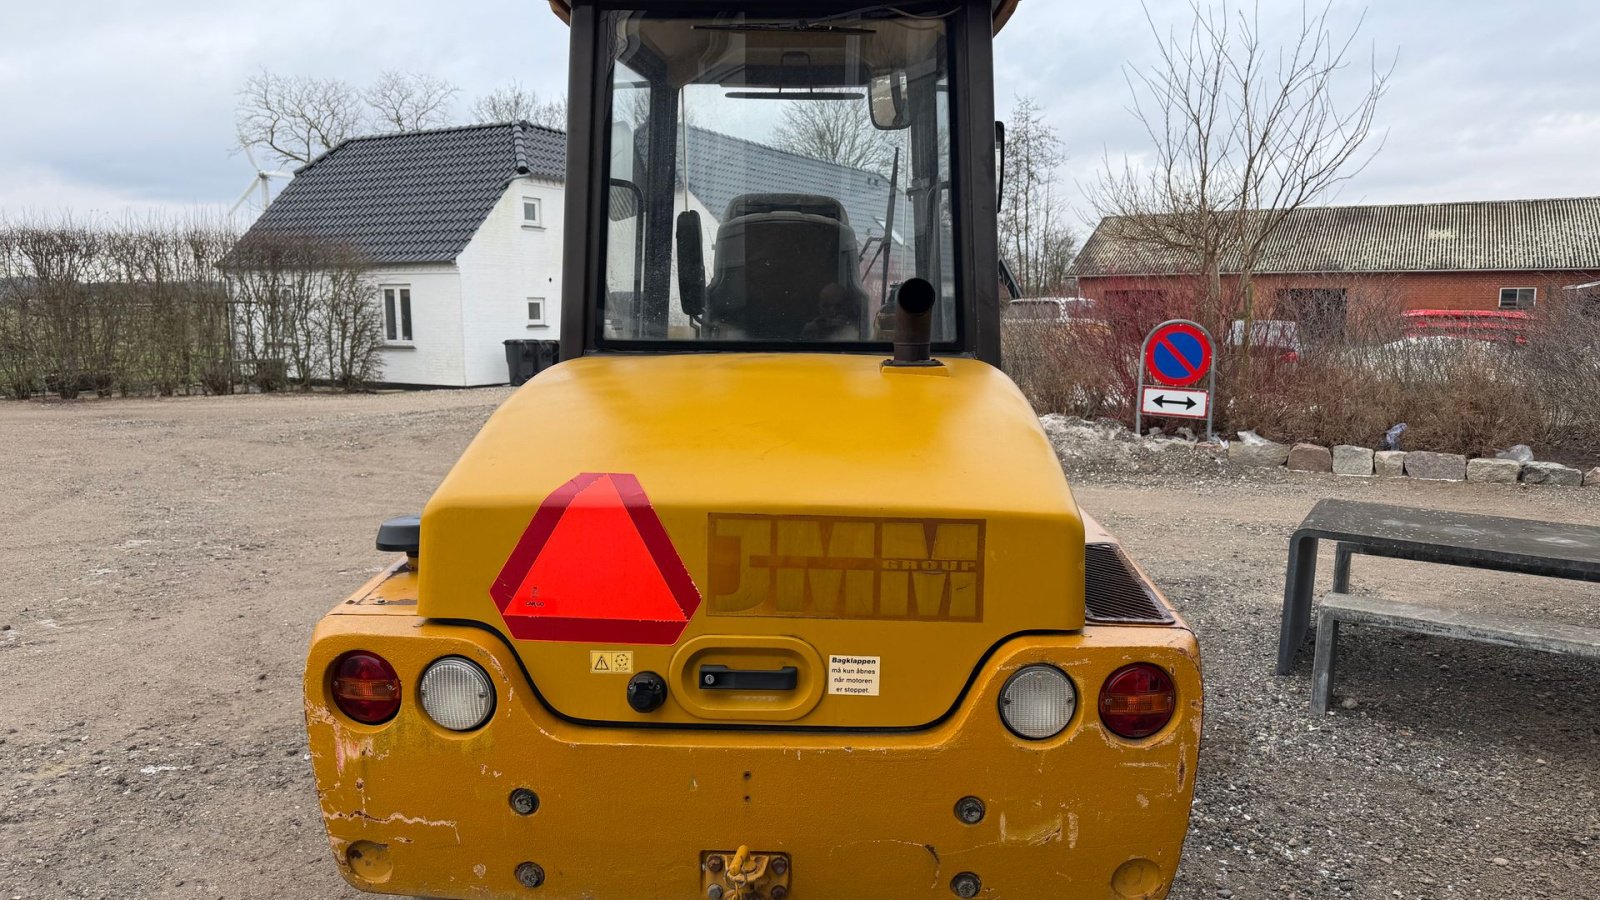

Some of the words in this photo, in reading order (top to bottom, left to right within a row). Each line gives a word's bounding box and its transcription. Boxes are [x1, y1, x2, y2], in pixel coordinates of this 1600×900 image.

[716, 518, 978, 617] JMM
[882, 559, 976, 572] GROUP
[832, 657, 876, 665] Bagklappen
